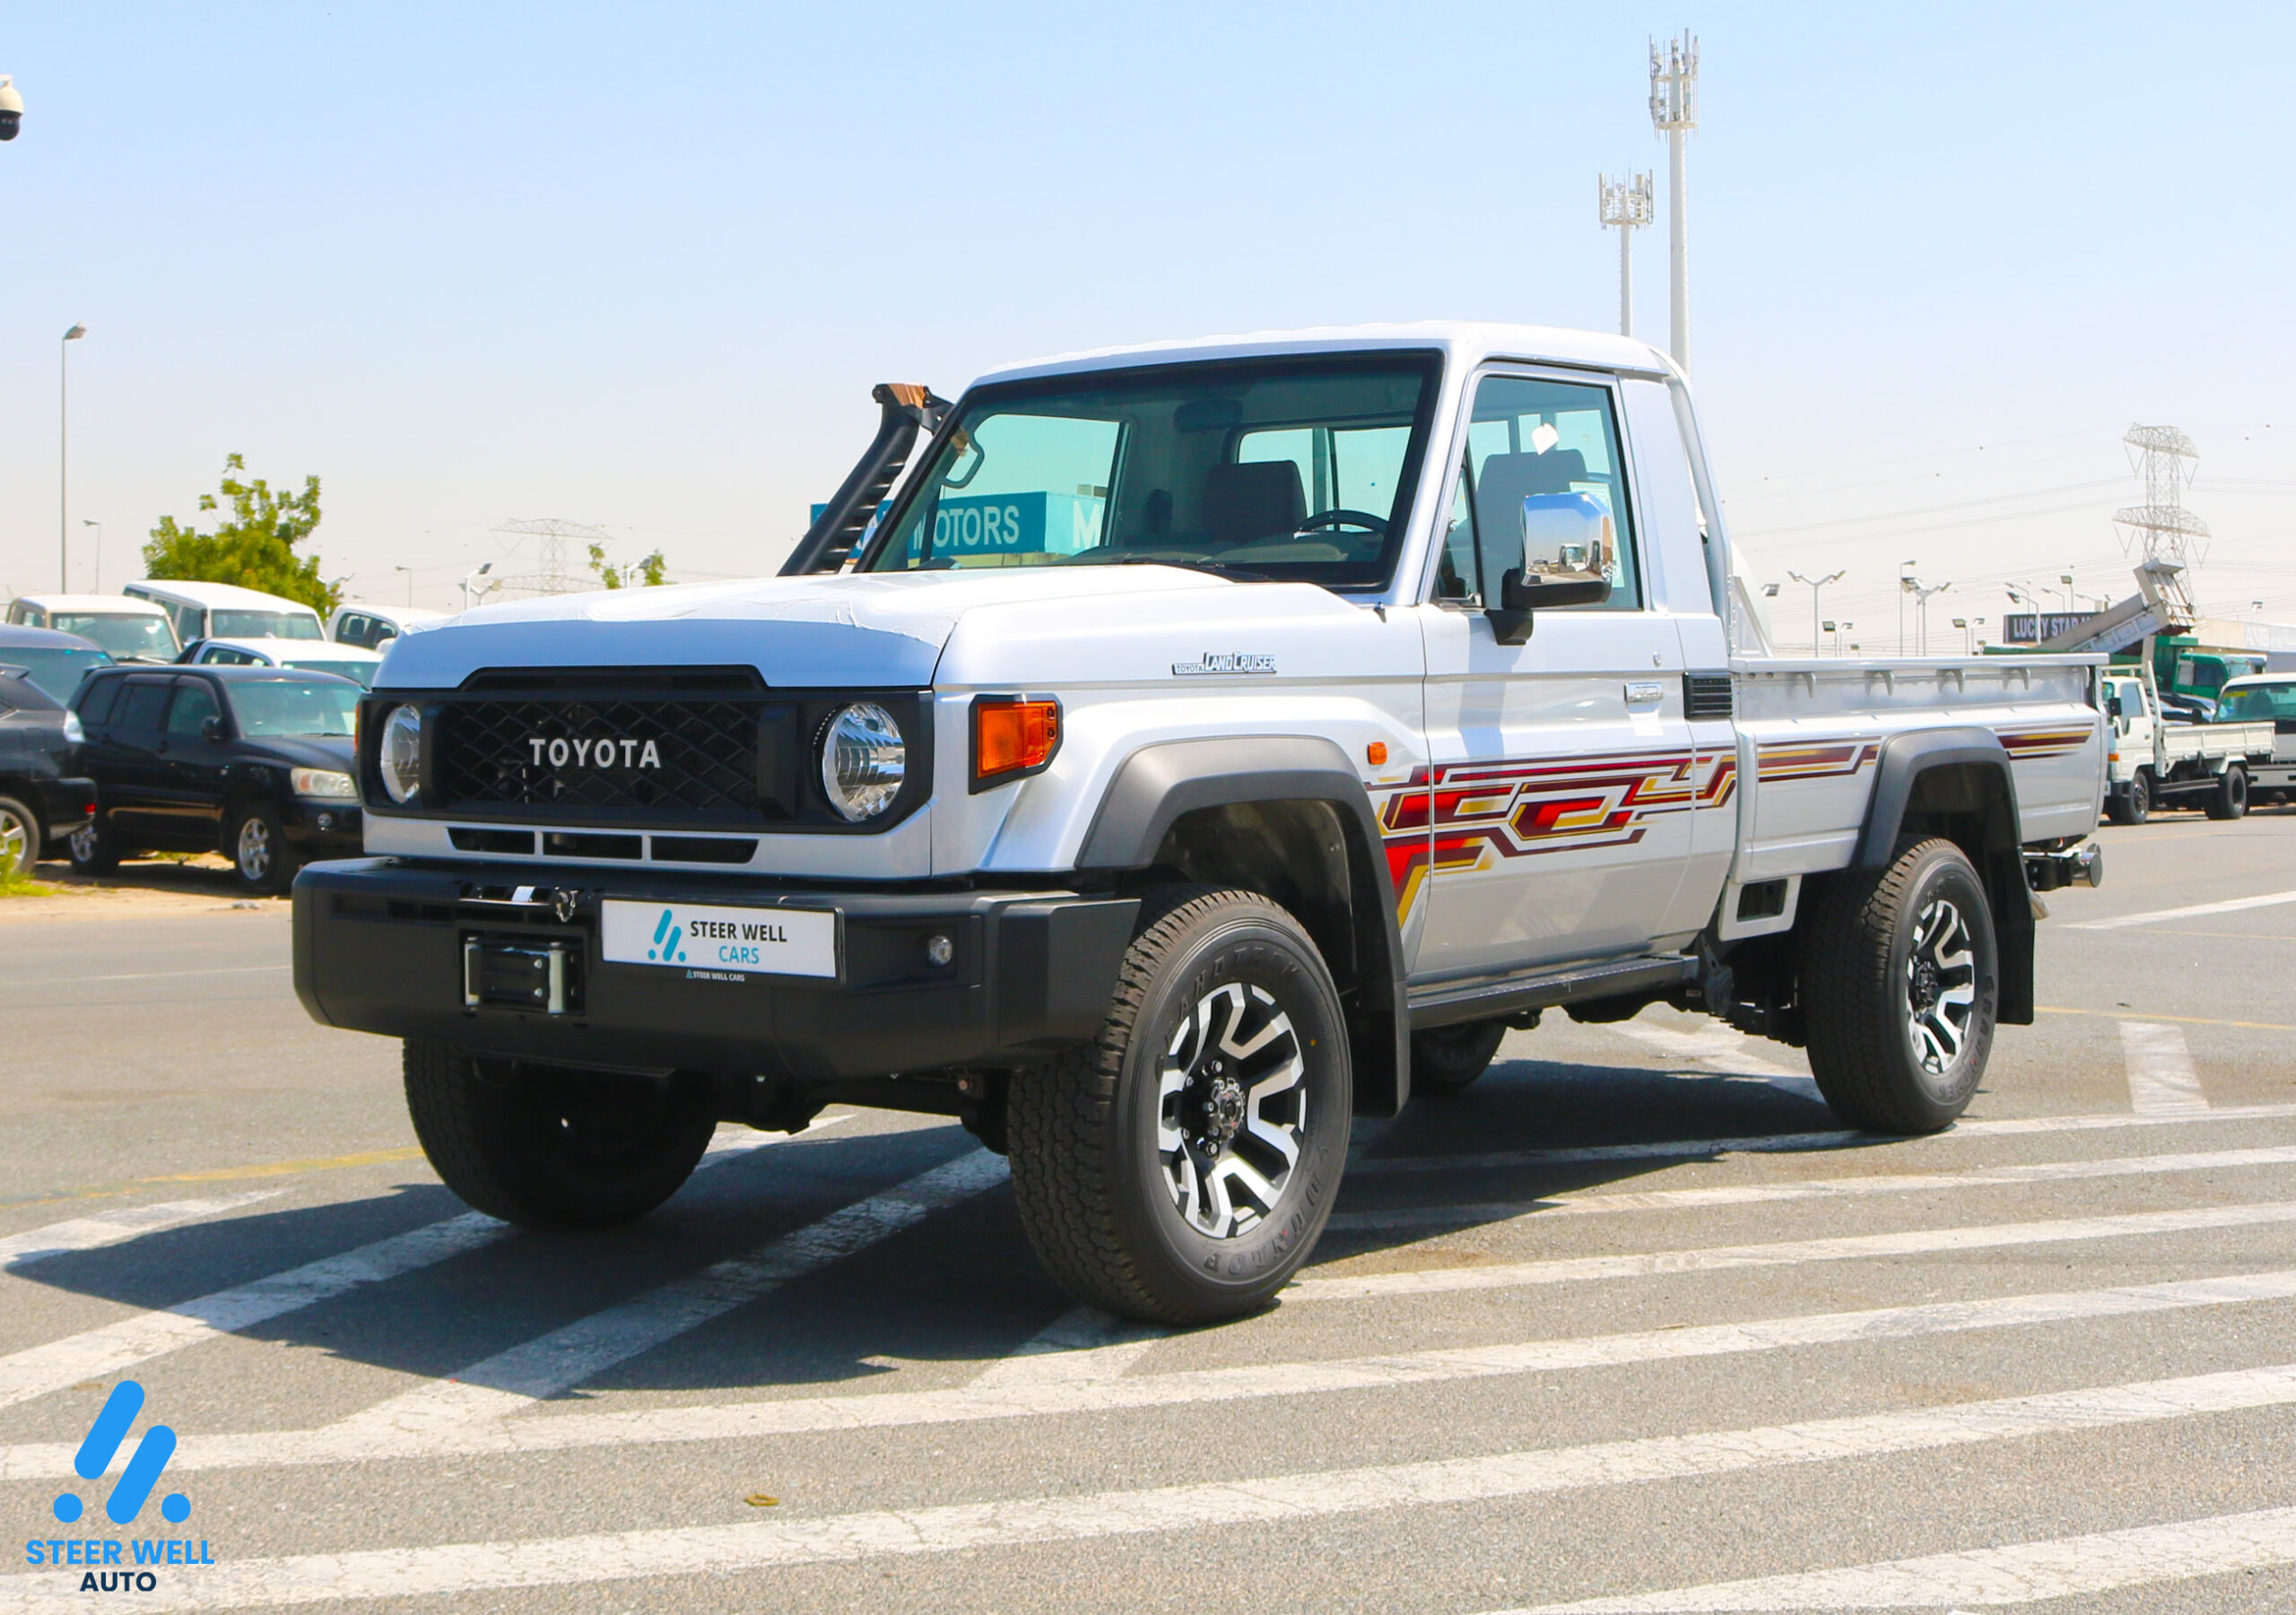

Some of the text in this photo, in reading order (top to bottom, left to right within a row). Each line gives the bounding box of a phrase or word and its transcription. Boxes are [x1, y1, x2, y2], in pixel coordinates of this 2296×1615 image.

[2013, 618, 2048, 638] LUCY
[1177, 664, 1203, 673] TOYOTA
[529, 738, 661, 768] TOYOTA
[690, 920, 787, 942] STEER WELL
[718, 945, 760, 965] CARS
[692, 970, 745, 982] STEER WELL CARS
